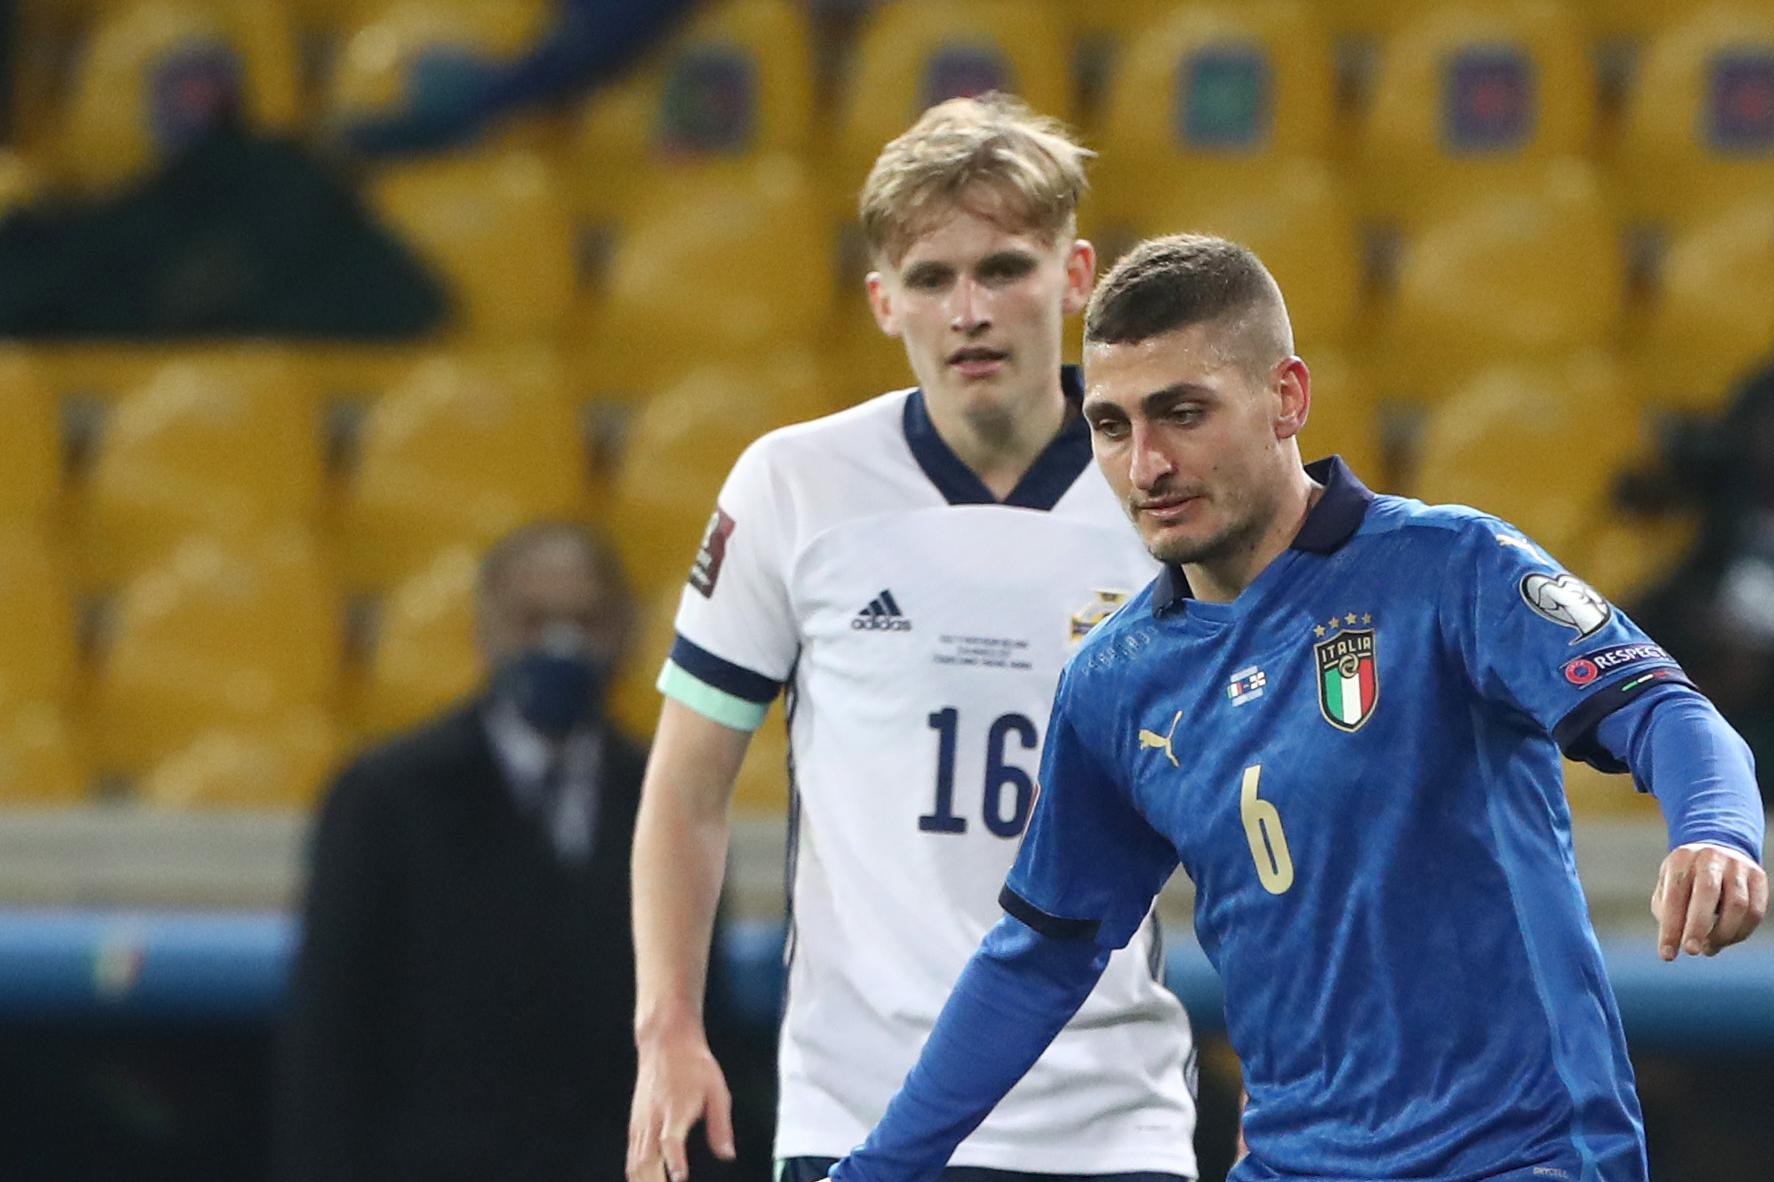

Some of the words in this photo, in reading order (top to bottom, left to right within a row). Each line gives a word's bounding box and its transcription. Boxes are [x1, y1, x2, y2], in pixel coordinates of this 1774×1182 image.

[851, 615, 911, 632] adidas
[1321, 636, 1371, 663] ITALIA
[918, 707, 1038, 839] 16
[1240, 764, 1294, 895] 6
